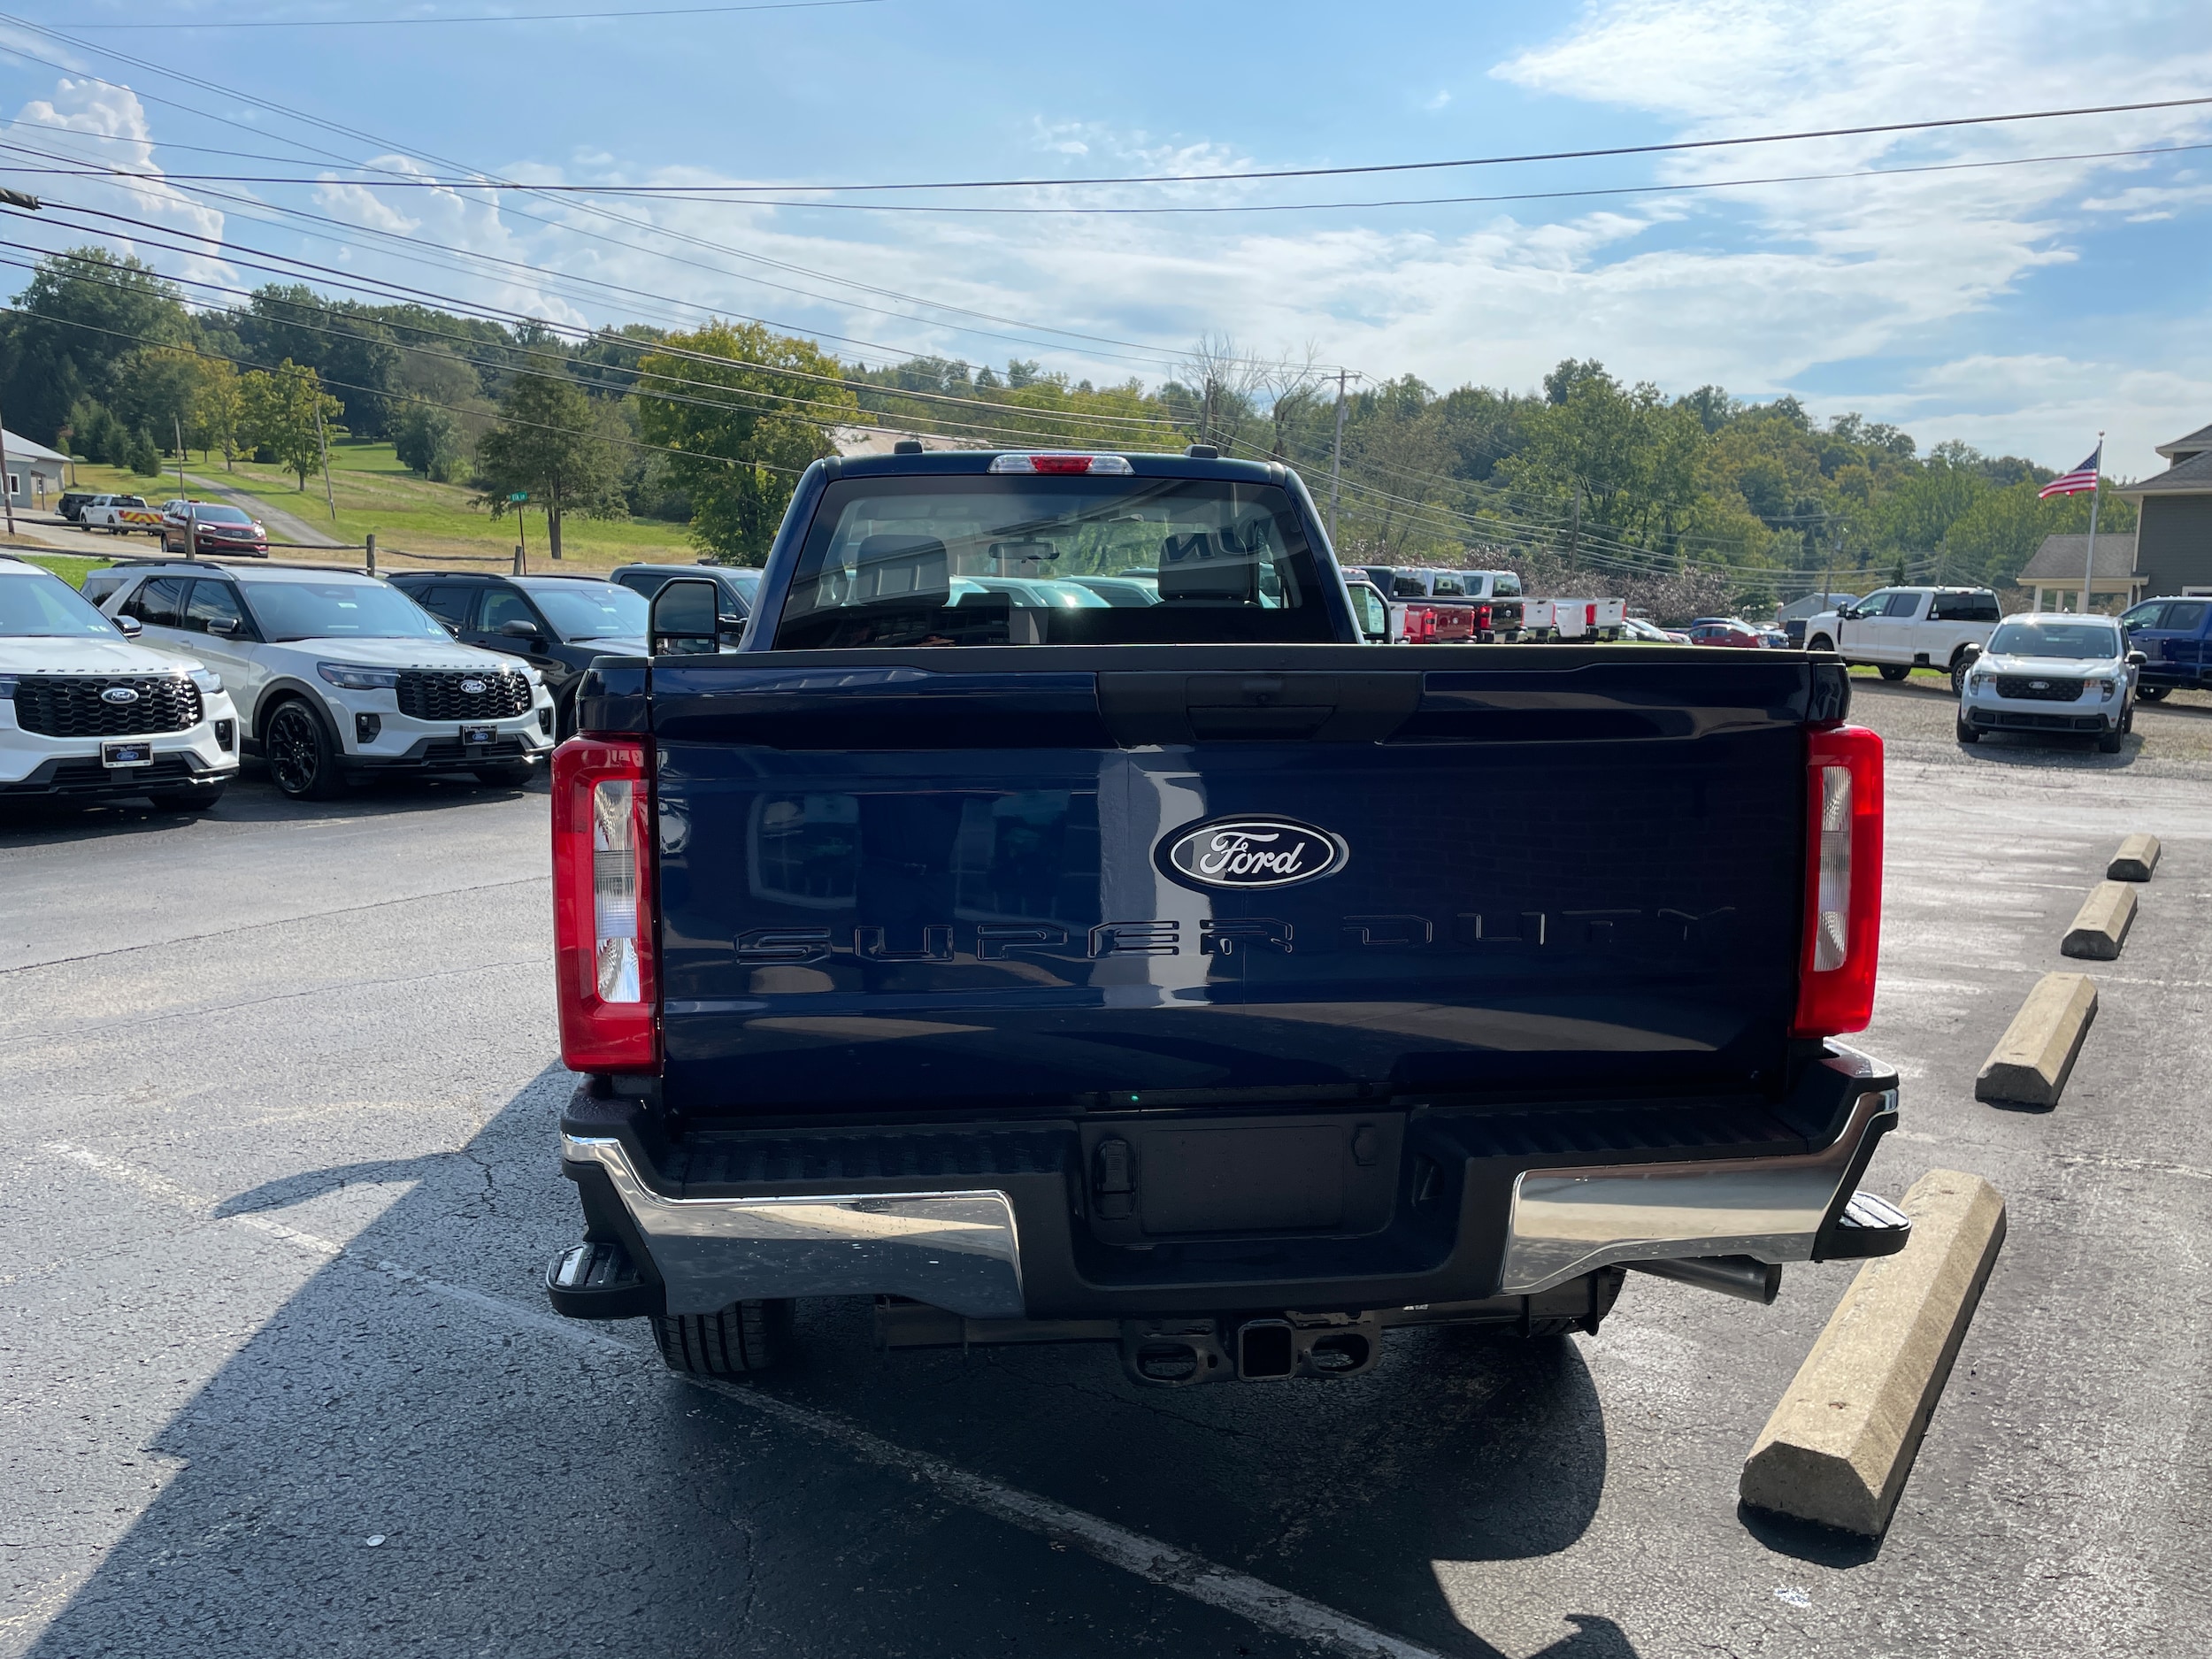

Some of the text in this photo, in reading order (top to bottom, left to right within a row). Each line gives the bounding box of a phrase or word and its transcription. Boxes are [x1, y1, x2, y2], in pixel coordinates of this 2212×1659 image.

[1199, 831, 1306, 875] Ford
[733, 905, 1737, 966] SUPER DUTY
